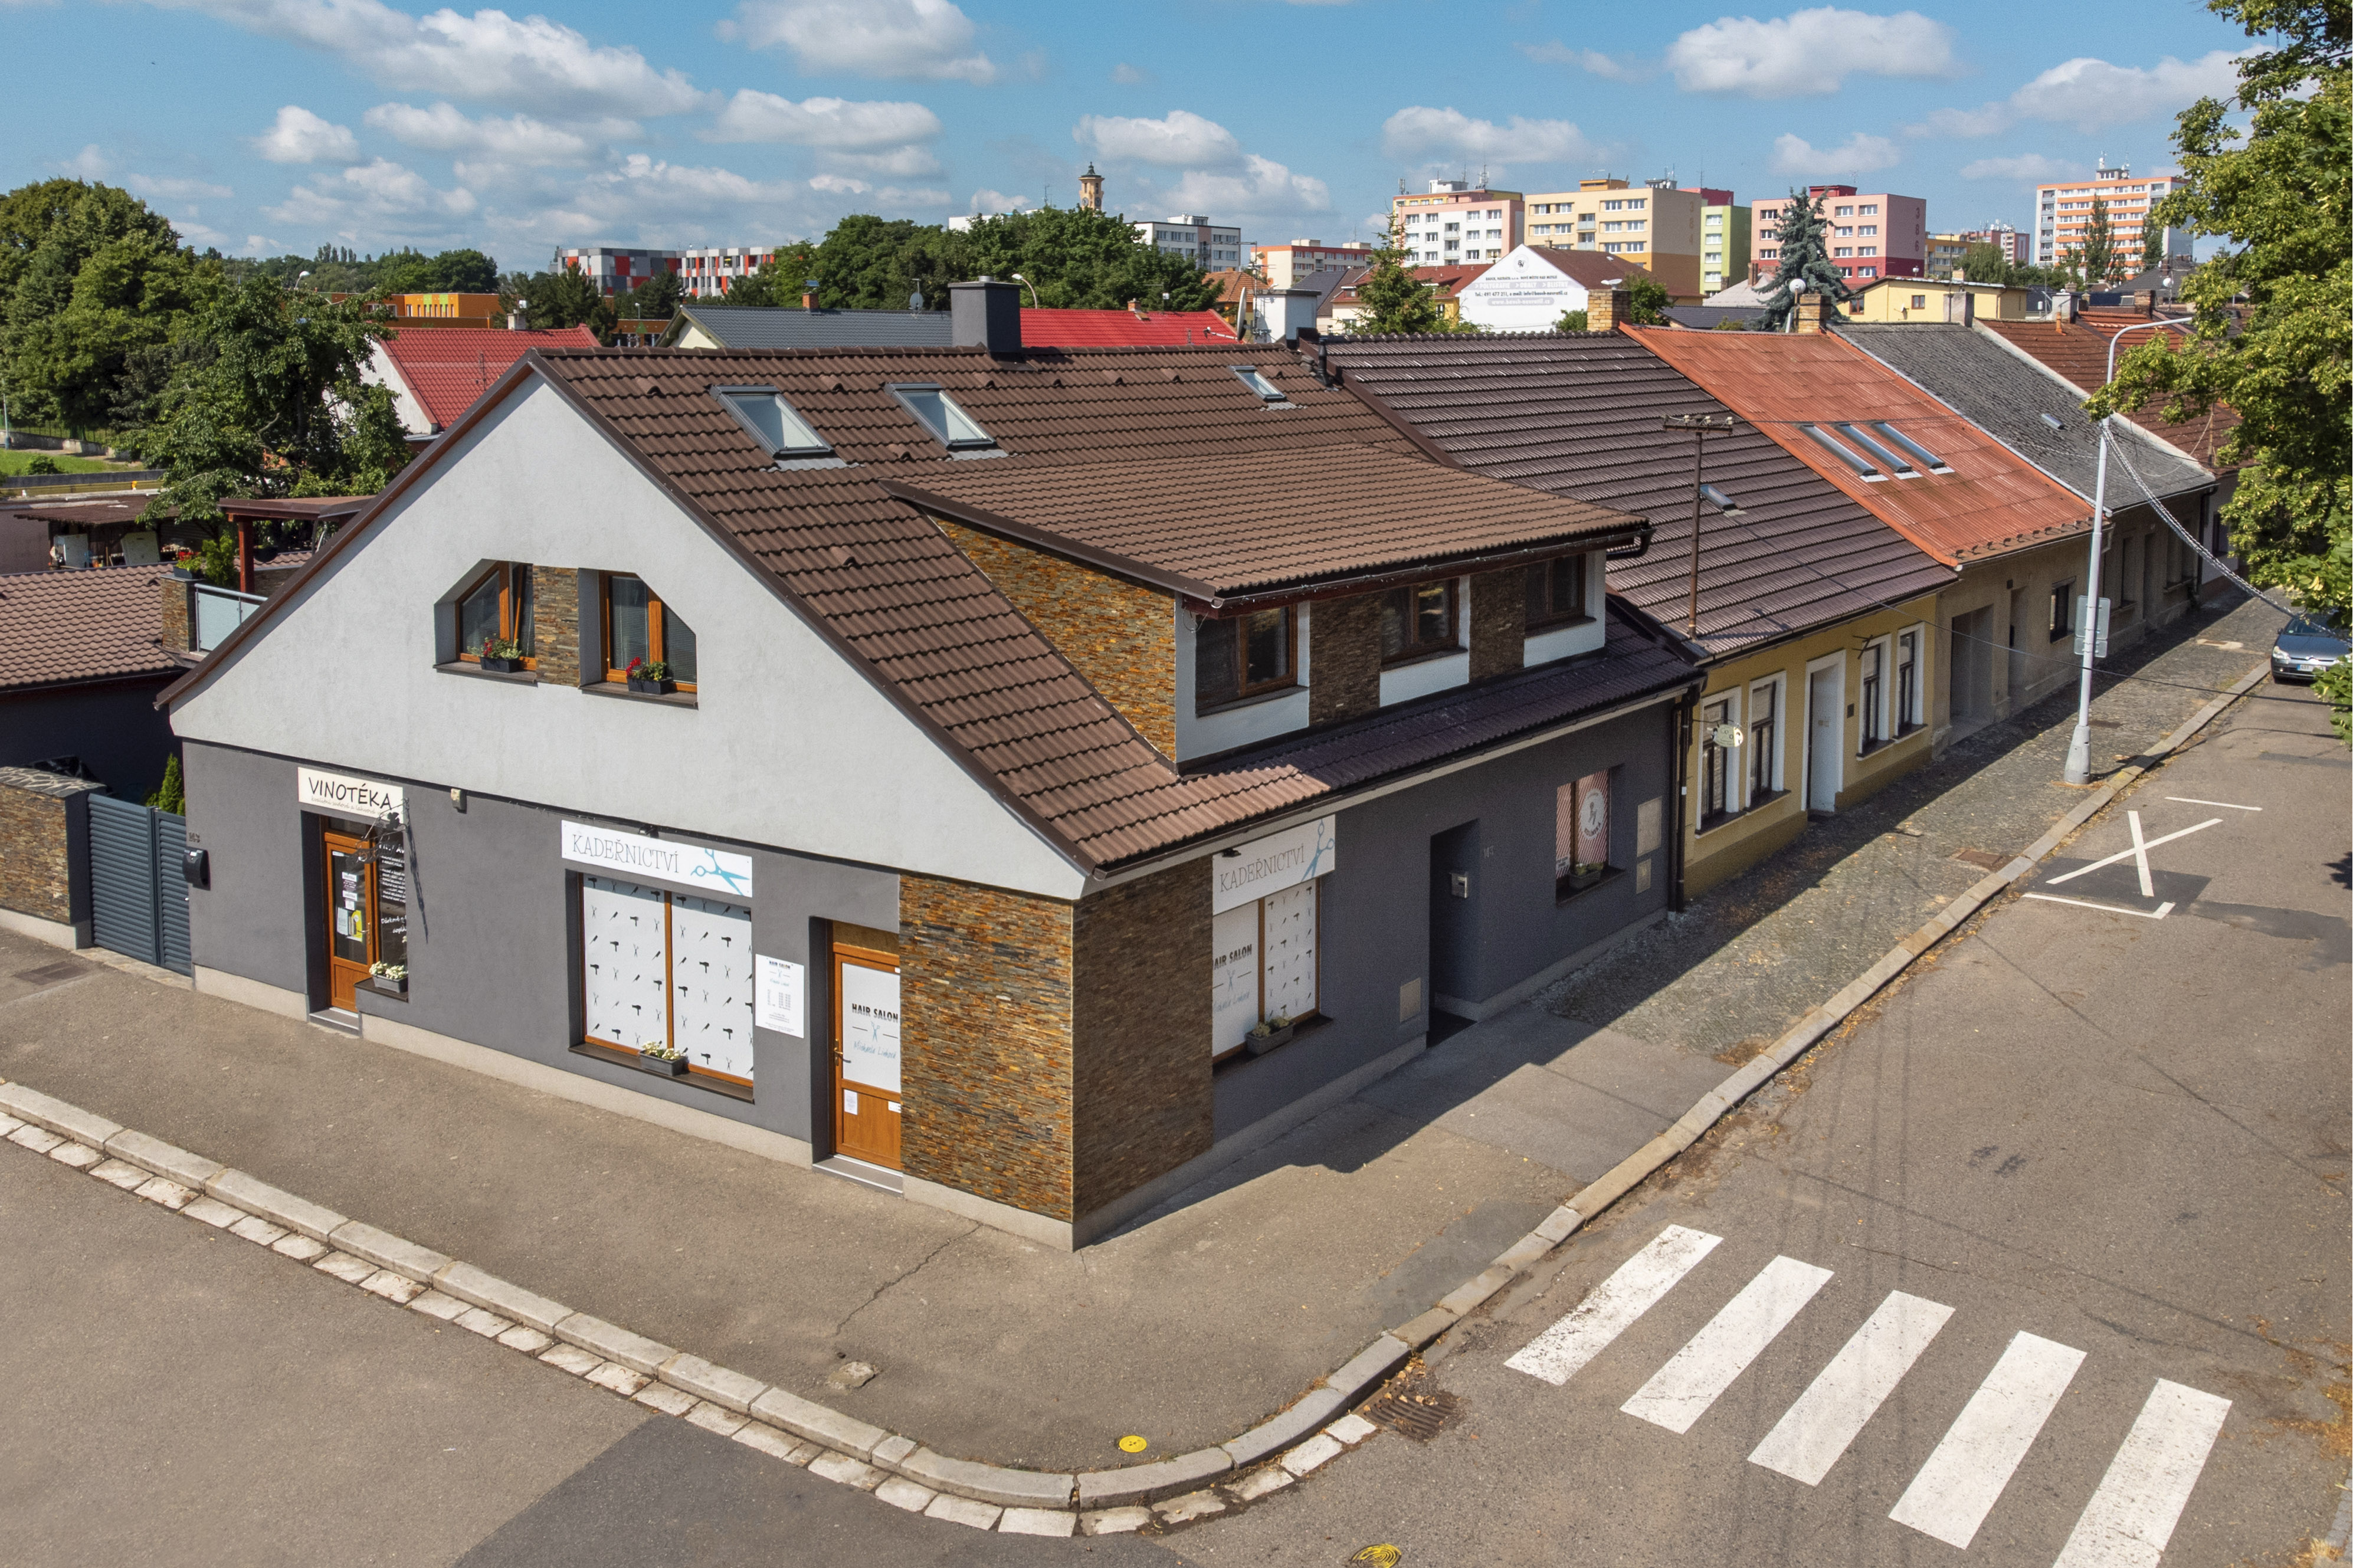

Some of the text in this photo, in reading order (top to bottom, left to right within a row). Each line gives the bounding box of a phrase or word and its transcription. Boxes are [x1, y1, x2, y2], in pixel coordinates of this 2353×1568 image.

[309, 776, 392, 811] VINOTÉKA
[572, 834, 679, 874] KADEŘNICTVÍ
[1220, 842, 1305, 893] KADEŘNICTVÍ
[1212, 943, 1252, 970] AIR SALON
[851, 1003, 898, 1024] HAIR SALON
